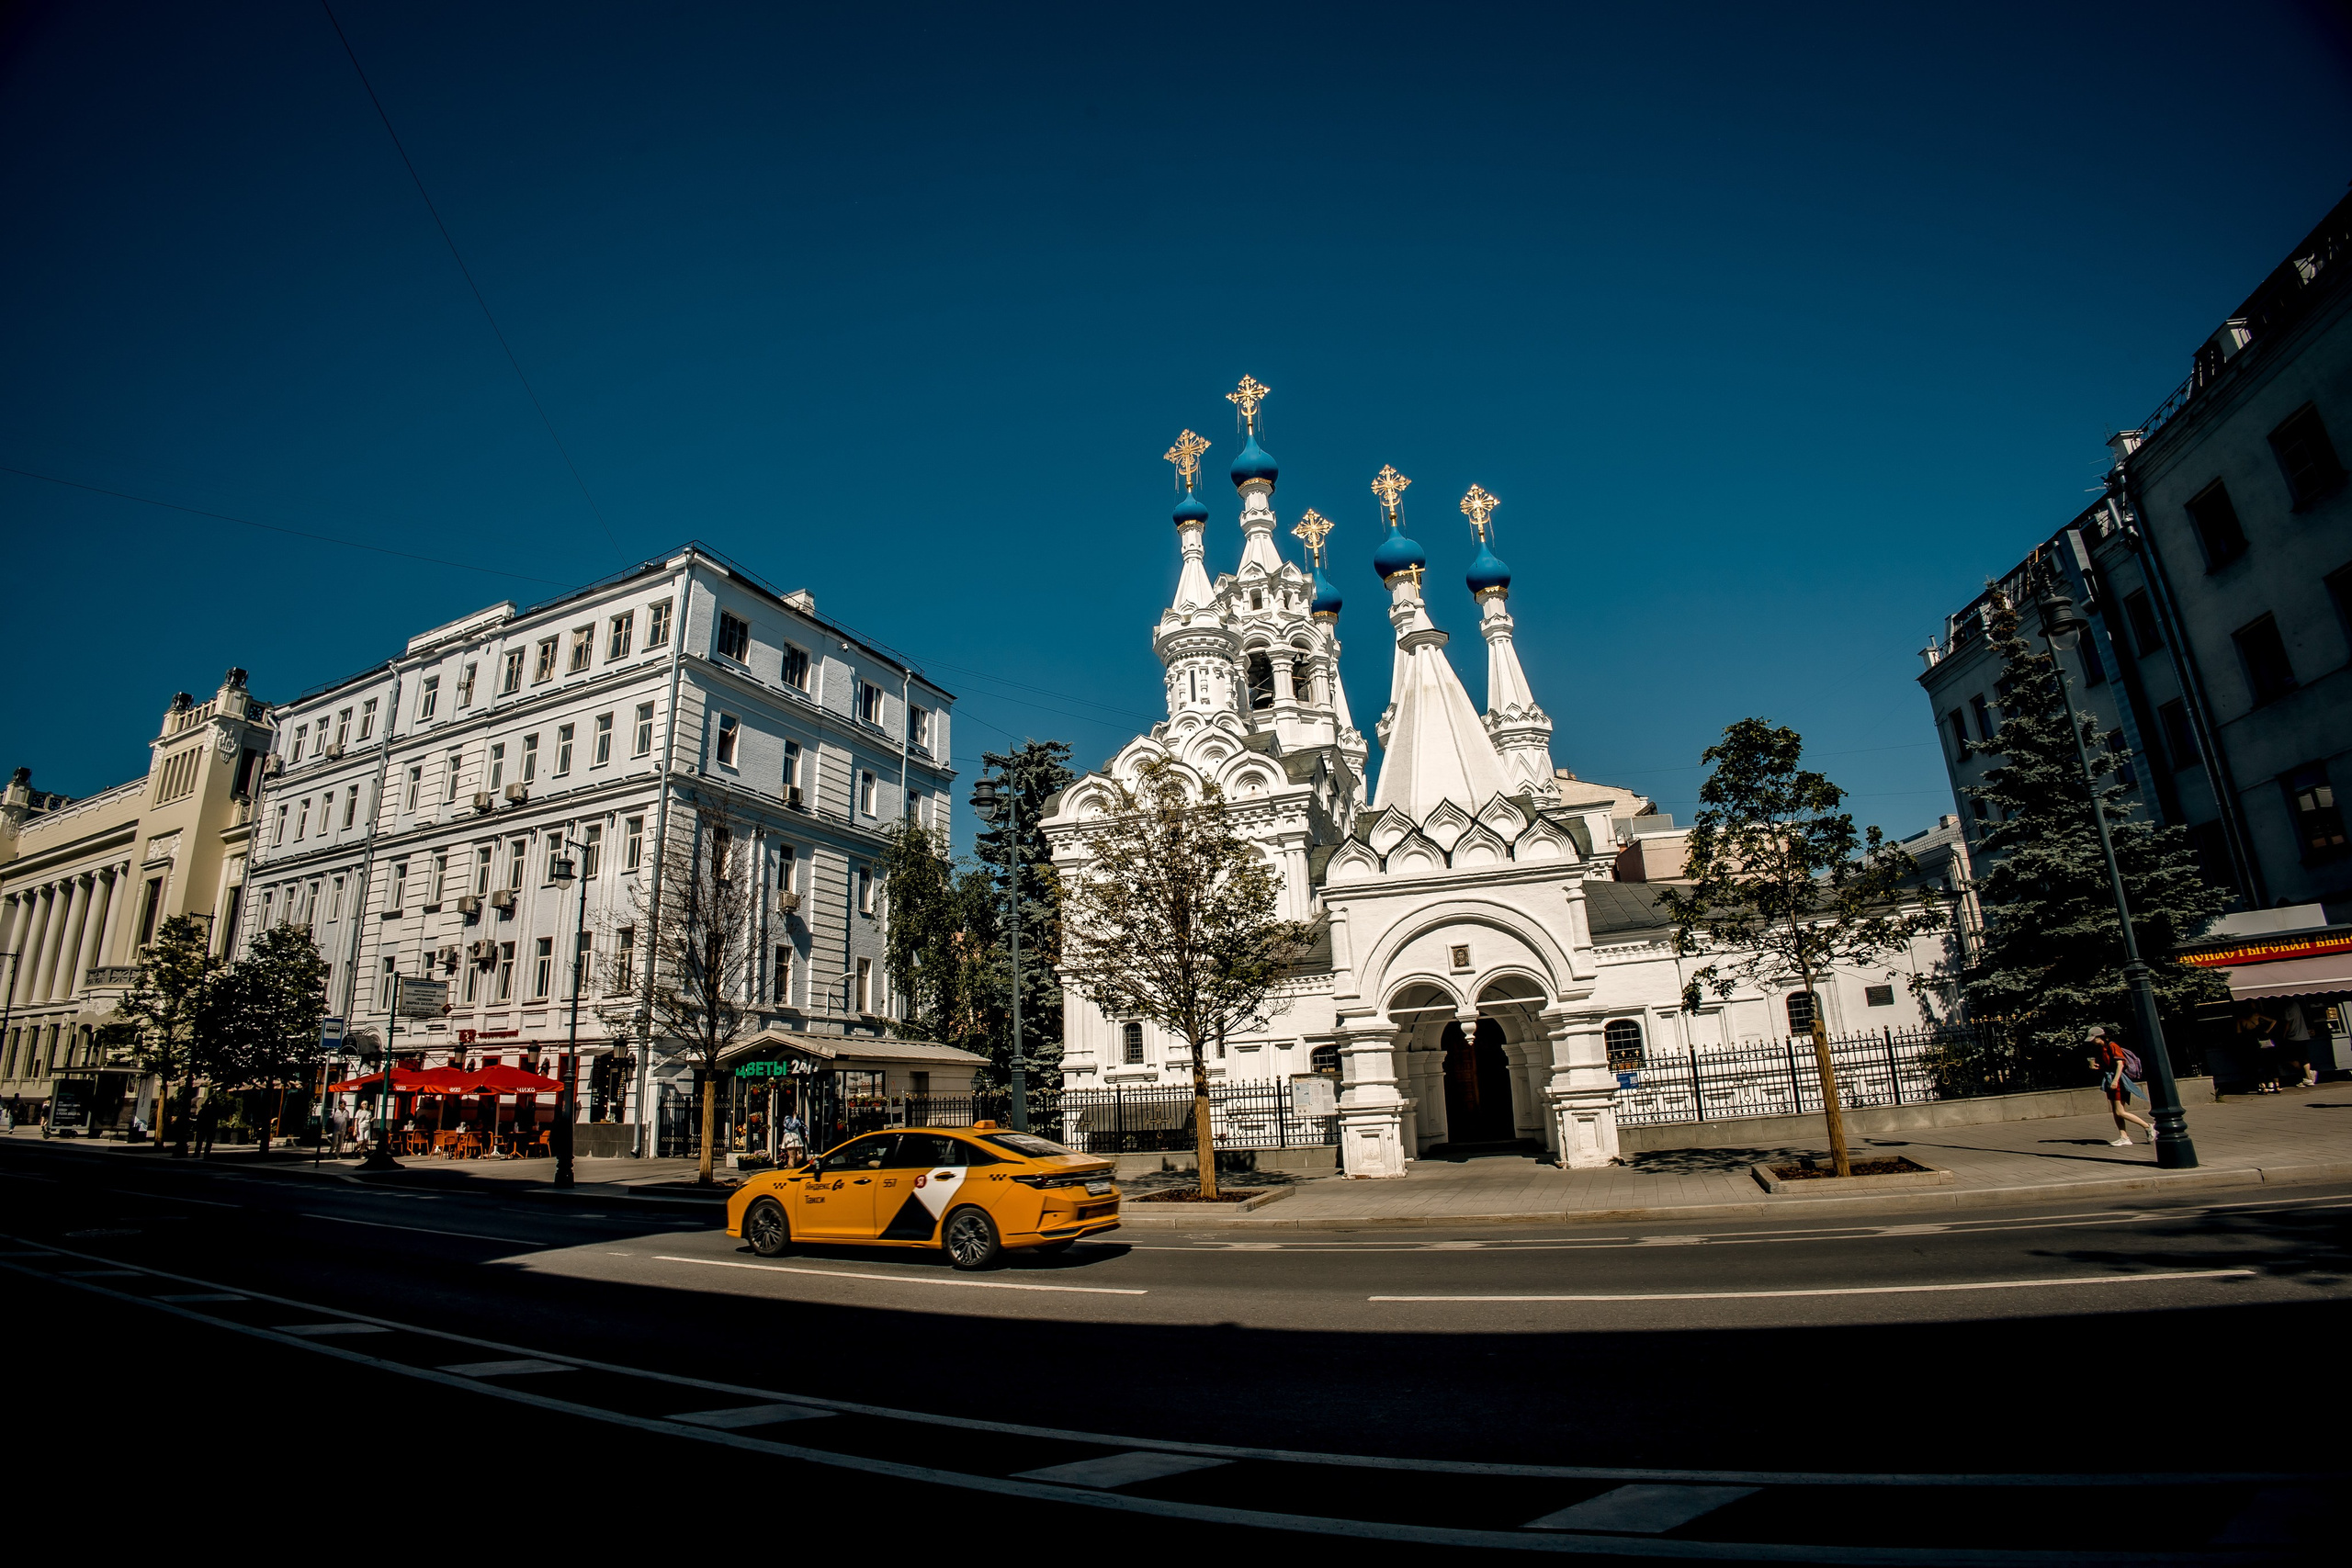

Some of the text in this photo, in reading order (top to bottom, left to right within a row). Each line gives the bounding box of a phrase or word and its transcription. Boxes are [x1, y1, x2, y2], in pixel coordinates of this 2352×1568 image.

[735, 1060, 787, 1079] ЦВЕТЫ
[804, 1179, 845, 1191] Яндекс Go
[804, 1194, 826, 1204] Такси
